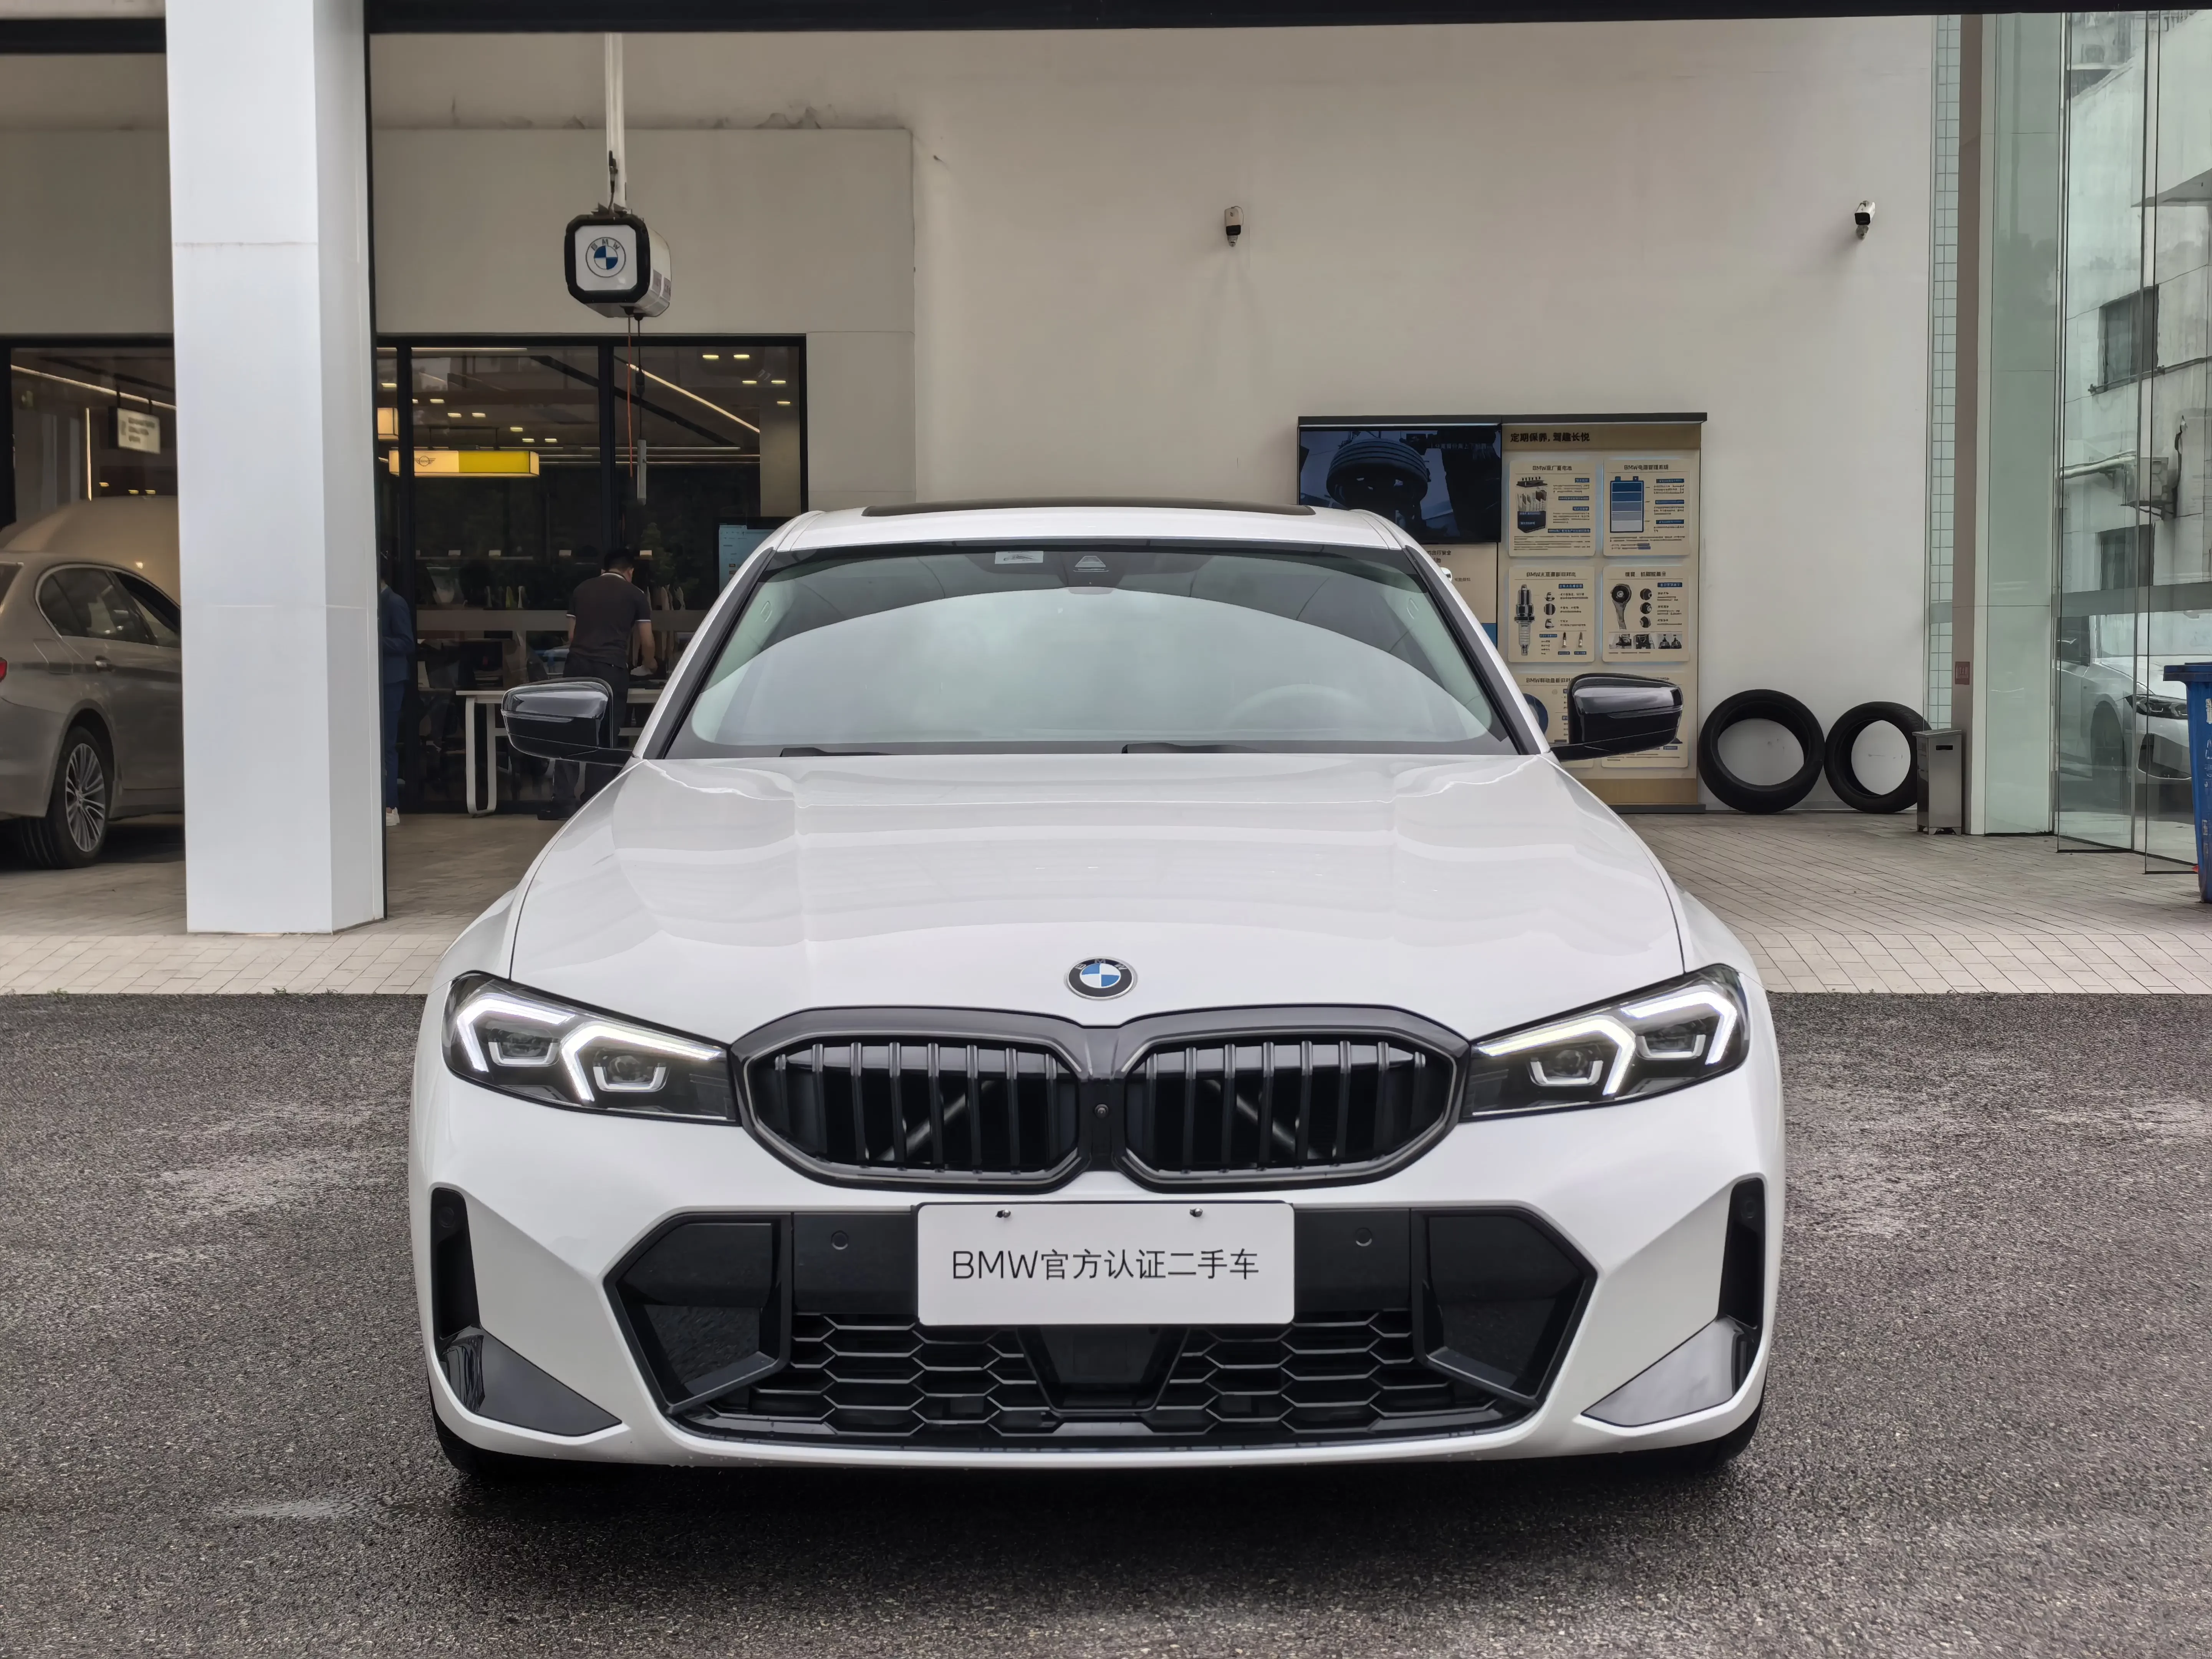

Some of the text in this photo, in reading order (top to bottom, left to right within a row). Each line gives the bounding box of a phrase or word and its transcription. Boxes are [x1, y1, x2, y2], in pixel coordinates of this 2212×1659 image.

[590, 238, 620, 251] BMW
[1075, 959, 1128, 970] BMW
[952, 1248, 1259, 1280] BMW官方认证二手车
